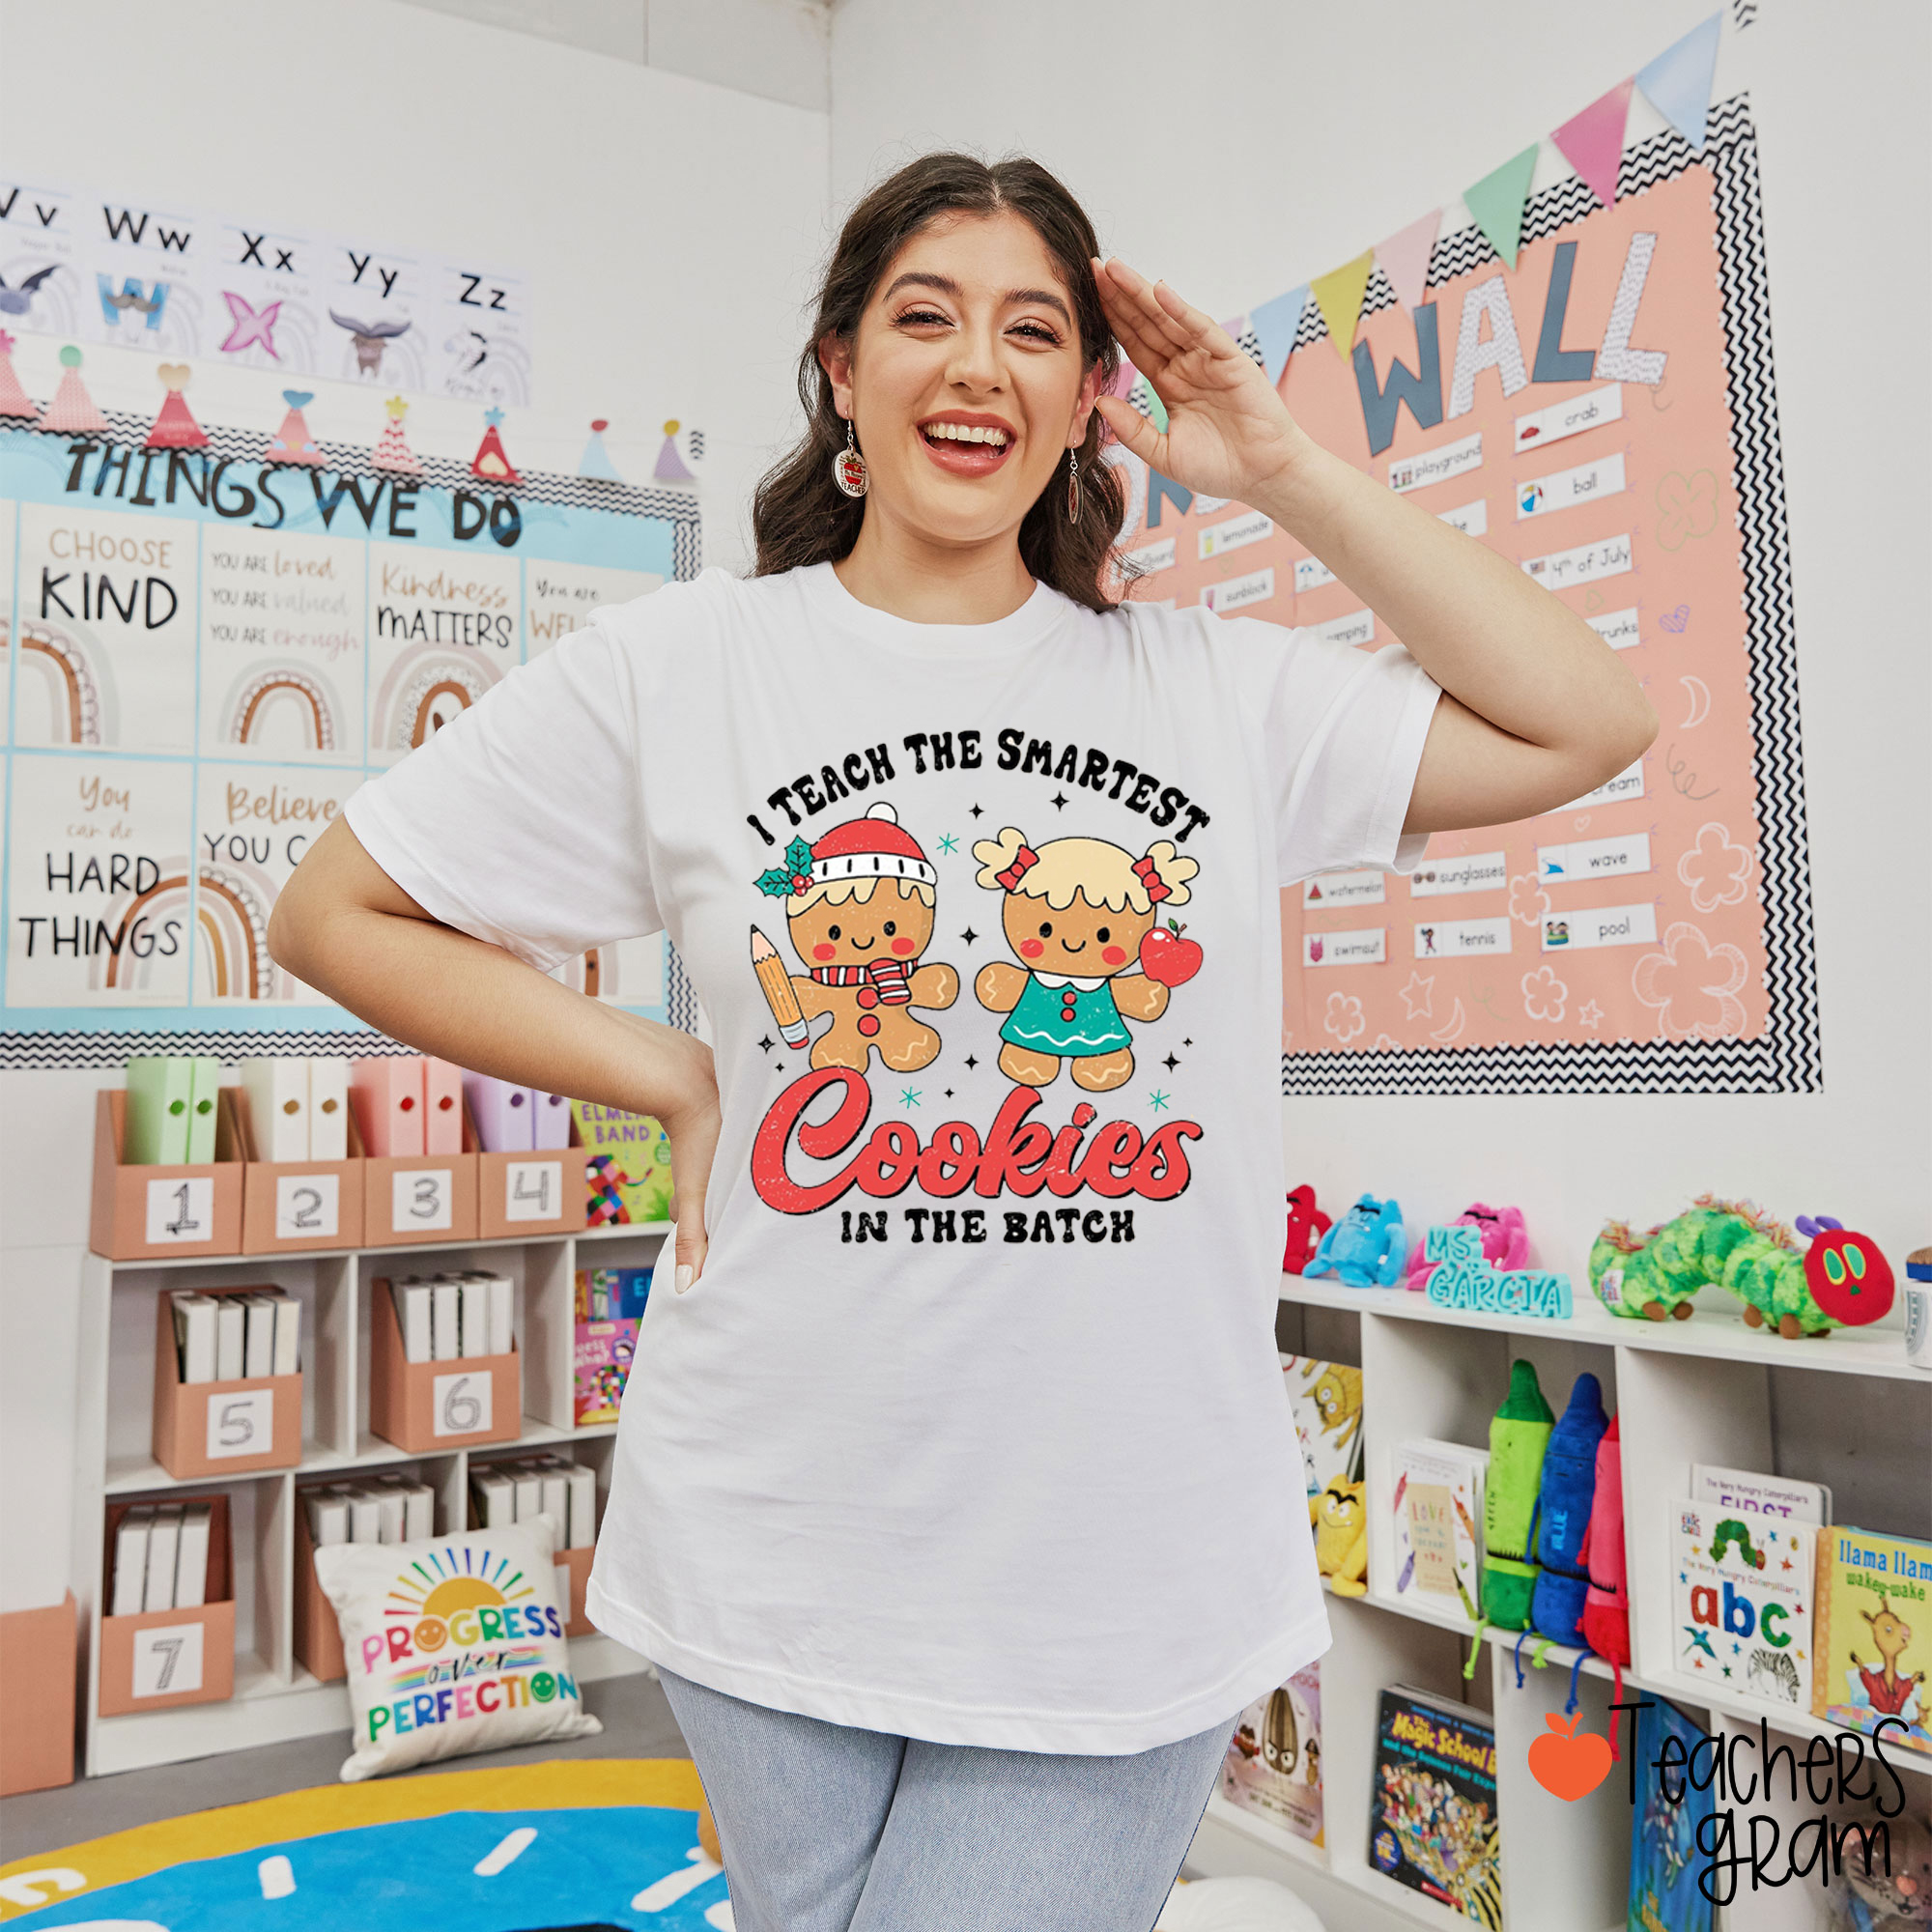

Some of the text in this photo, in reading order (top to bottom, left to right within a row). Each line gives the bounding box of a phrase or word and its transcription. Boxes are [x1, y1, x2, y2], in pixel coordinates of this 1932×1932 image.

[1351, 232, 1668, 458] WALL
[1564, 402, 1599, 427] crab
[1414, 443, 1483, 480] playground
[1573, 471, 1598, 495] ball
[66, 443, 523, 548] THINGS WE DO
[49, 528, 173, 569] CHOOSE
[212, 552, 241, 572] YOU
[273, 549, 335, 581] loved
[1577, 552, 1595, 573] of
[1599, 545, 1632, 568] July
[41, 565, 178, 630] KIND
[211, 587, 240, 608] YOU
[382, 563, 511, 610] Kindness
[210, 623, 240, 643] YOU
[378, 605, 514, 648] MATTERS
[79, 775, 130, 812] You
[227, 781, 341, 826] Believe
[746, 727, 1211, 846] I TEACH THE SMARTEST
[204, 833, 270, 864] YOU
[1587, 851, 1629, 869] wave
[46, 851, 160, 895] HARD
[1439, 865, 1506, 887] sunglasses
[17, 915, 183, 959] THINGS
[1459, 931, 1496, 948] tennis
[1599, 917, 1631, 940] pool
[595, 1124, 651, 1145] BAND
[750, 1065, 1205, 1216] Cookies
[165, 1181, 201, 1236] 1
[292, 1187, 323, 1229] 2
[409, 1177, 441, 1220] 3
[513, 1169, 550, 1212] 4
[839, 1208, 1136, 1244] IN THE BATCH
[1429, 1265, 1563, 1316] GARCIA
[217, 1400, 255, 1446] 5
[442, 1377, 482, 1431] 6
[1839, 1539, 1932, 1582] llama llam
[1690, 1580, 1792, 1648] abc
[362, 1605, 562, 1676] PROGRESS
[151, 1637, 185, 1691] 7
[428, 1650, 511, 1686] over
[368, 1671, 579, 1743] PERFECTION
[1436, 1727, 1489, 1771] School
